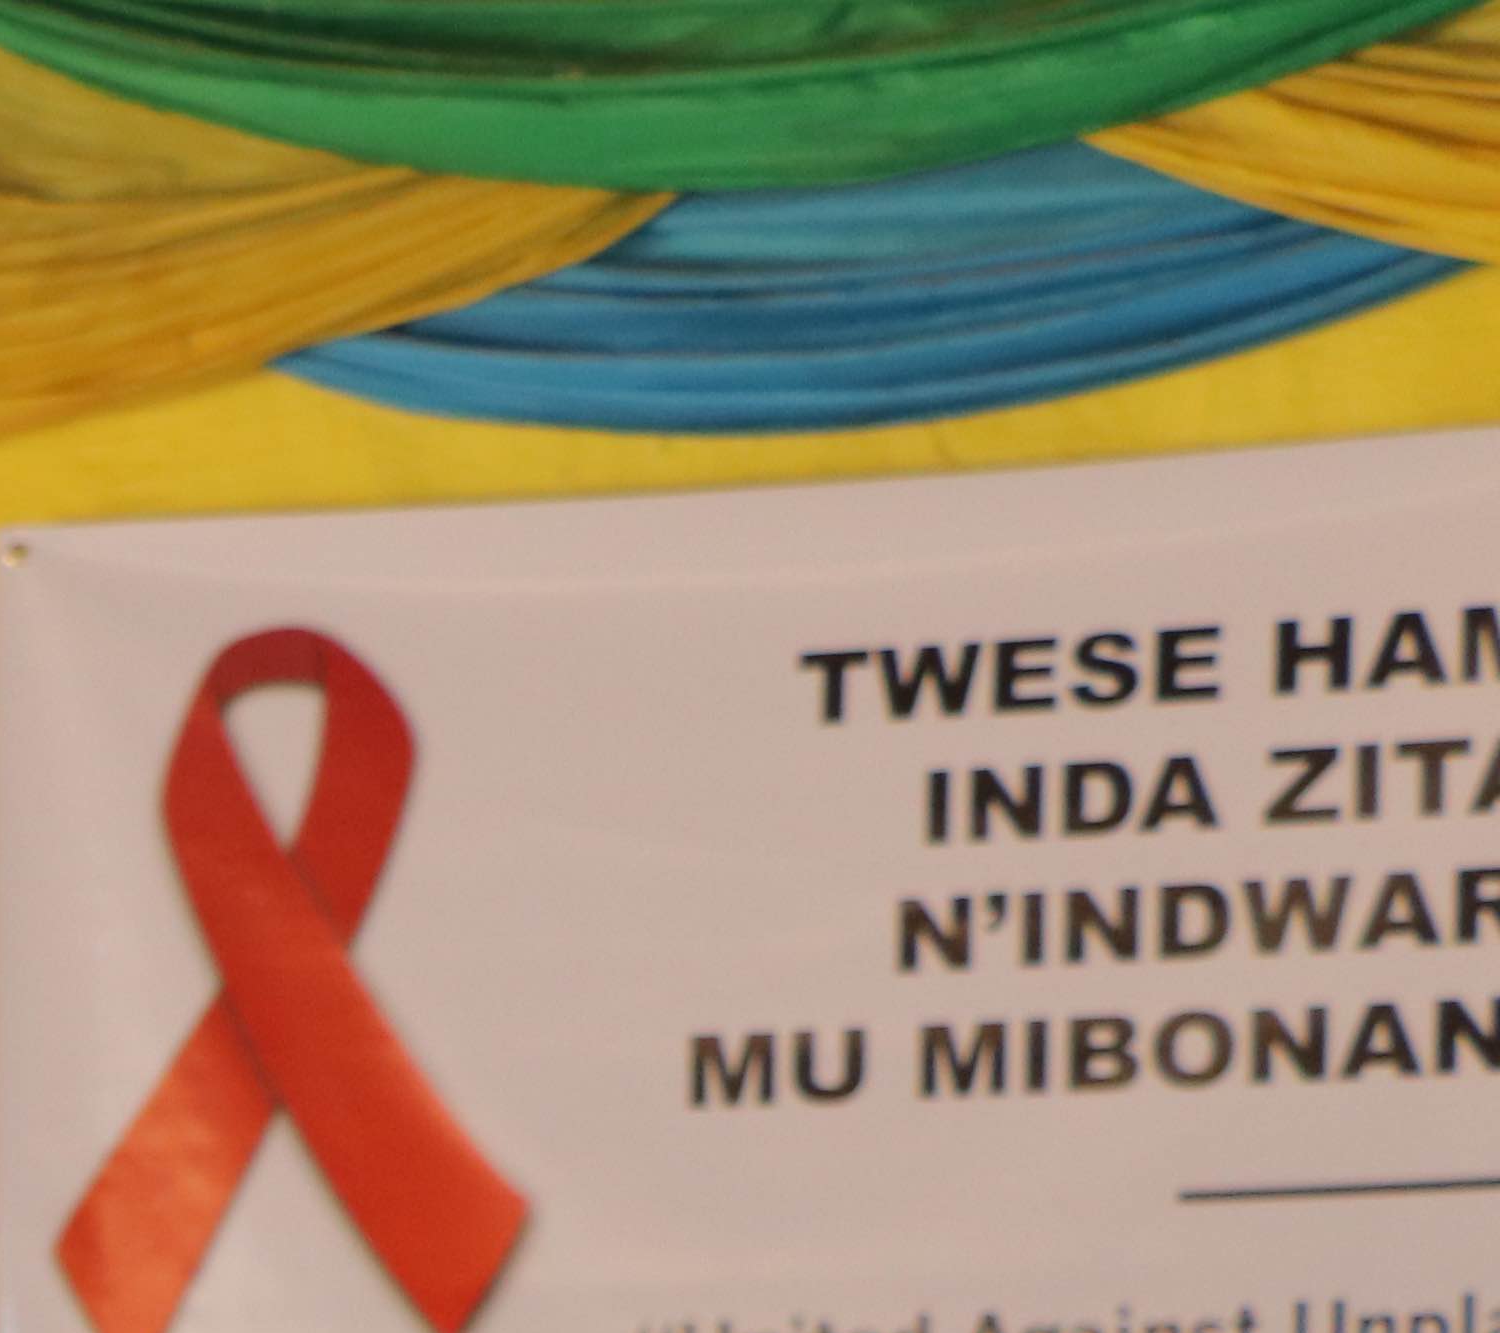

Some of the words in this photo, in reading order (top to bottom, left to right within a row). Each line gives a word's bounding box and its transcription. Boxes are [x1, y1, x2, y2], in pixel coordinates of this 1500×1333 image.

[799, 624, 1223, 725] TWESE
[926, 754, 1220, 845] INDA
[689, 1028, 868, 1109] MU
[919, 996, 1500, 1100] MIBONAN
